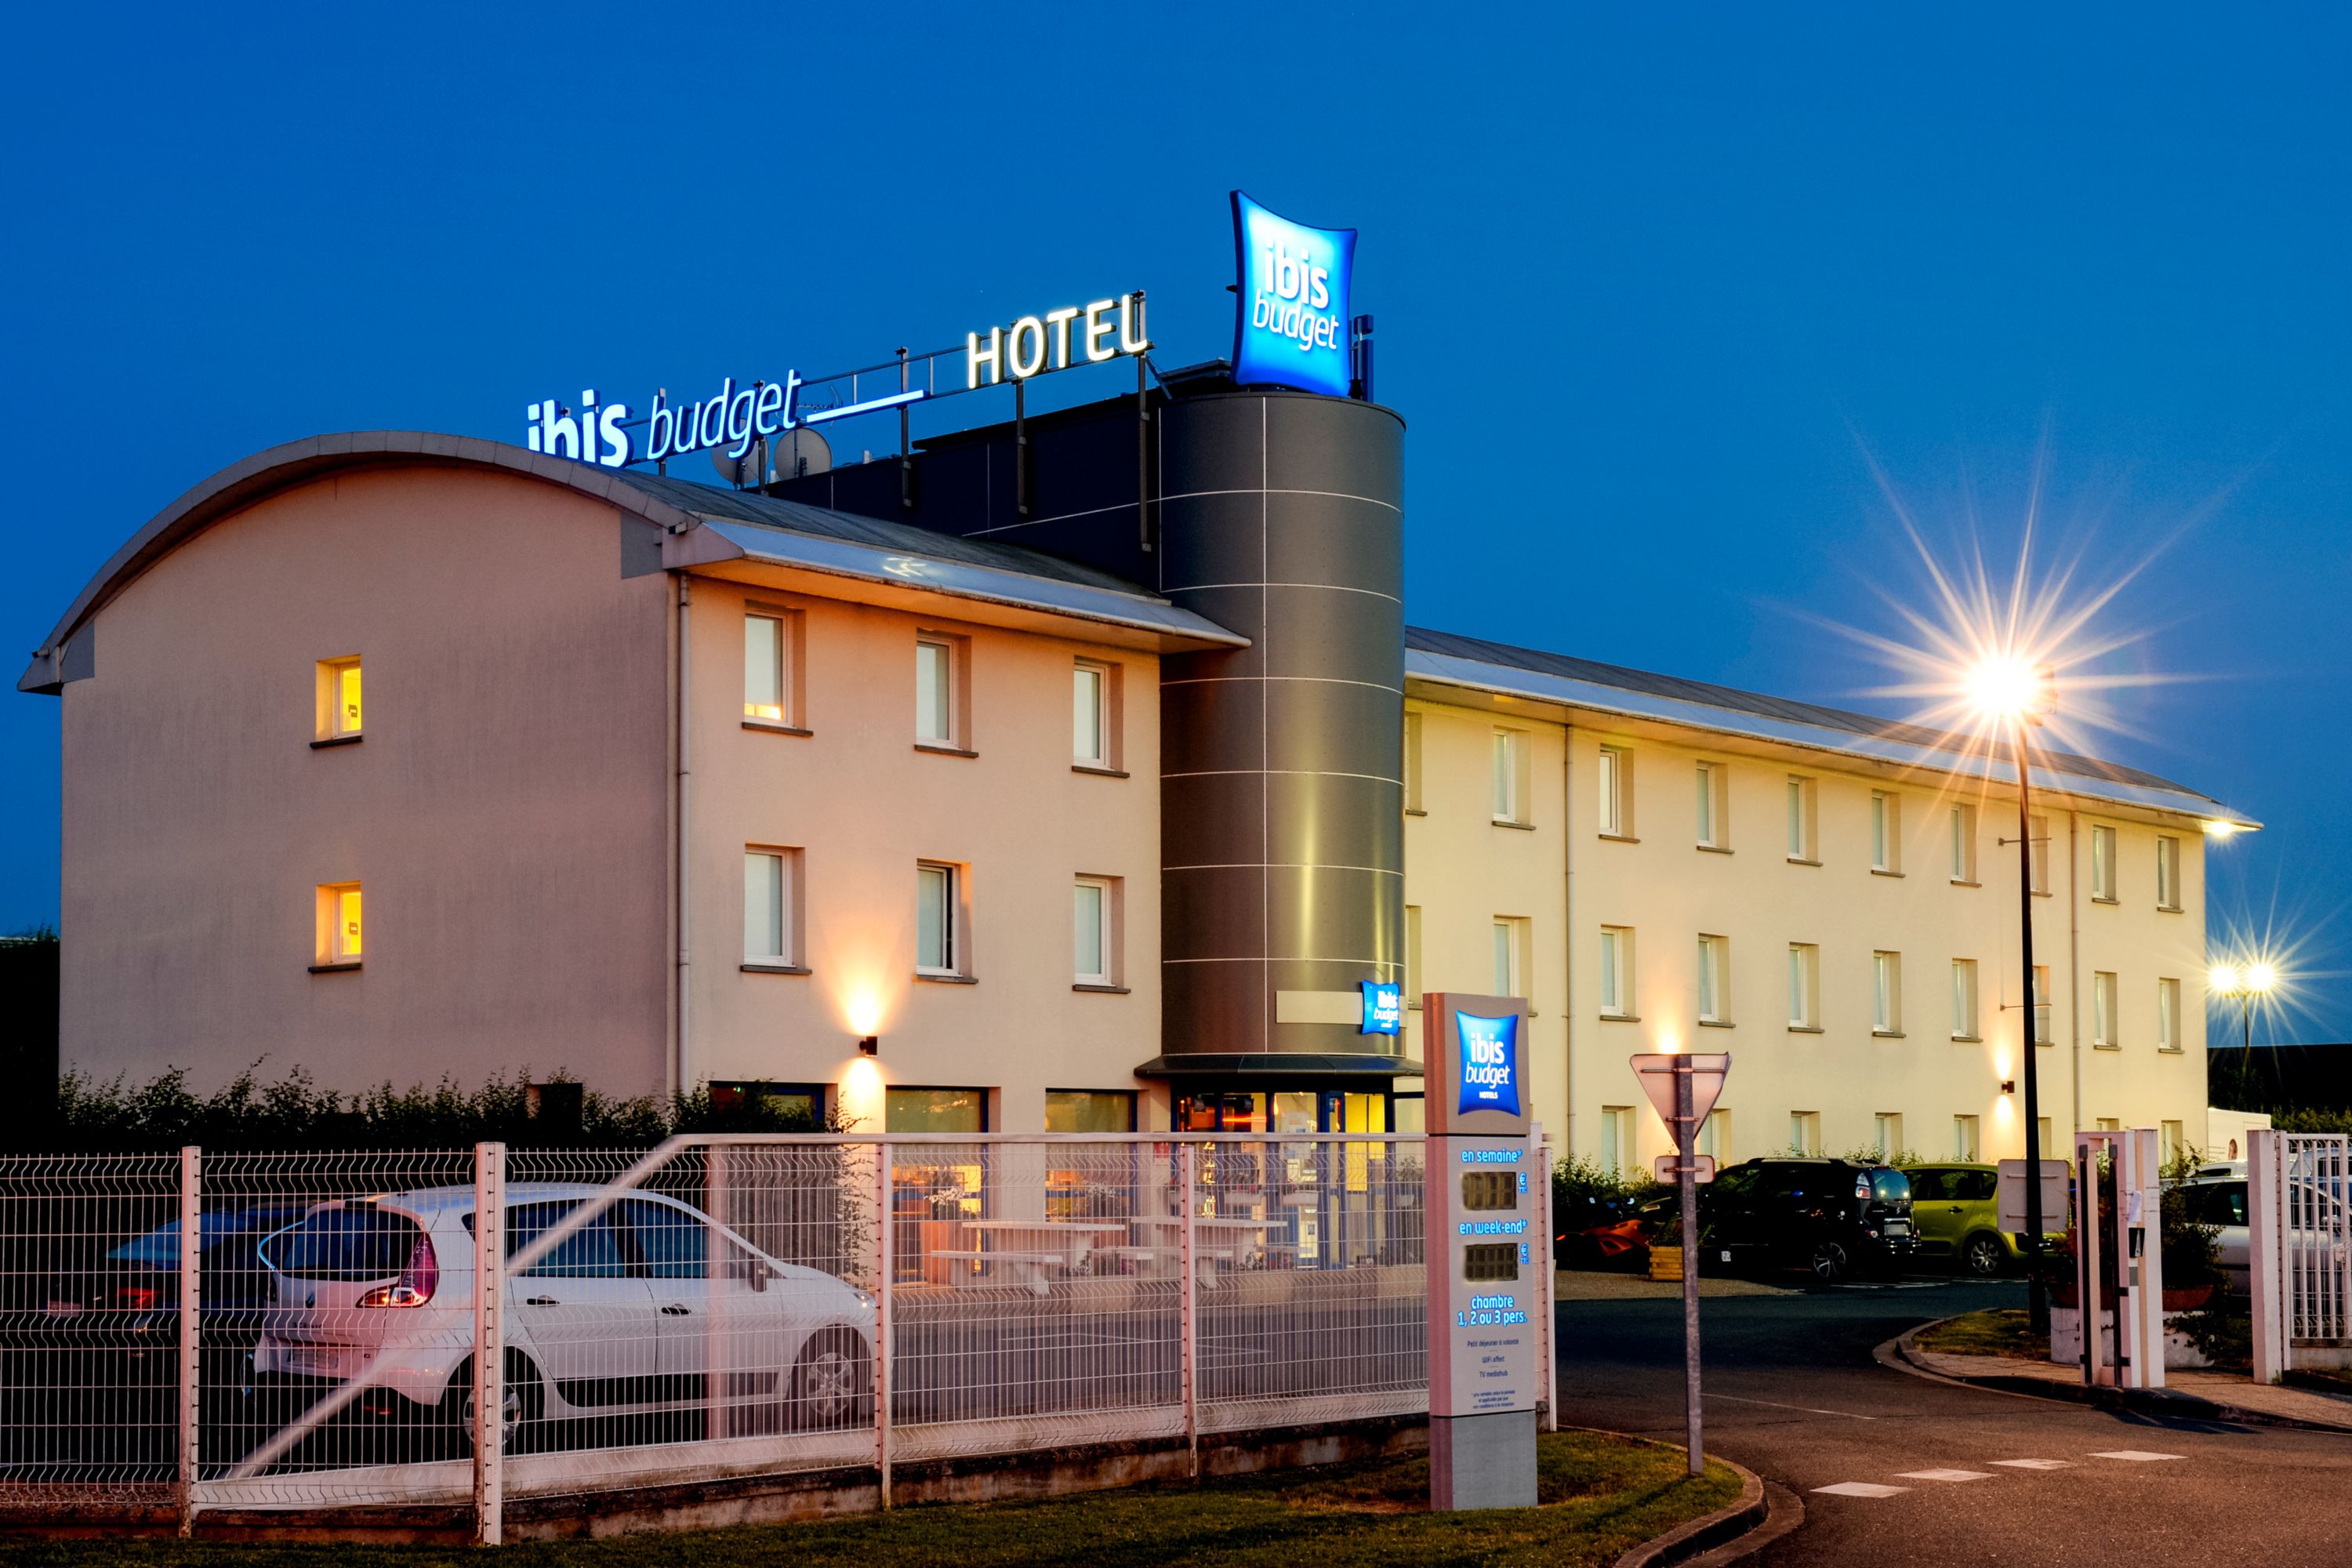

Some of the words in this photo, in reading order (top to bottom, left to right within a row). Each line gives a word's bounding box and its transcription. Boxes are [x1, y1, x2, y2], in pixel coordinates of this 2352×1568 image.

[1265, 236, 1329, 309] ibis
[1252, 288, 1339, 351] budget
[967, 293, 1148, 389] HOTEL
[647, 368, 802, 459] budget
[1377, 990, 1398, 1009] ibis
[1470, 1032, 1505, 1065] ibis
[1465, 1061, 1511, 1090] budget
[1461, 1150, 1474, 1163] en
[1519, 1172, 1527, 1185] €
[1459, 1222, 1472, 1235] en
[1520, 1243, 1529, 1257] €
[1472, 1294, 1514, 1309] chambre
[1458, 1311, 1468, 1327] 1,
[1470, 1310, 1478, 1326] 2
[1479, 1312, 1494, 1326] ou
[1494, 1308, 1501, 1324] 3
[1504, 1311, 1527, 1327] pers.
